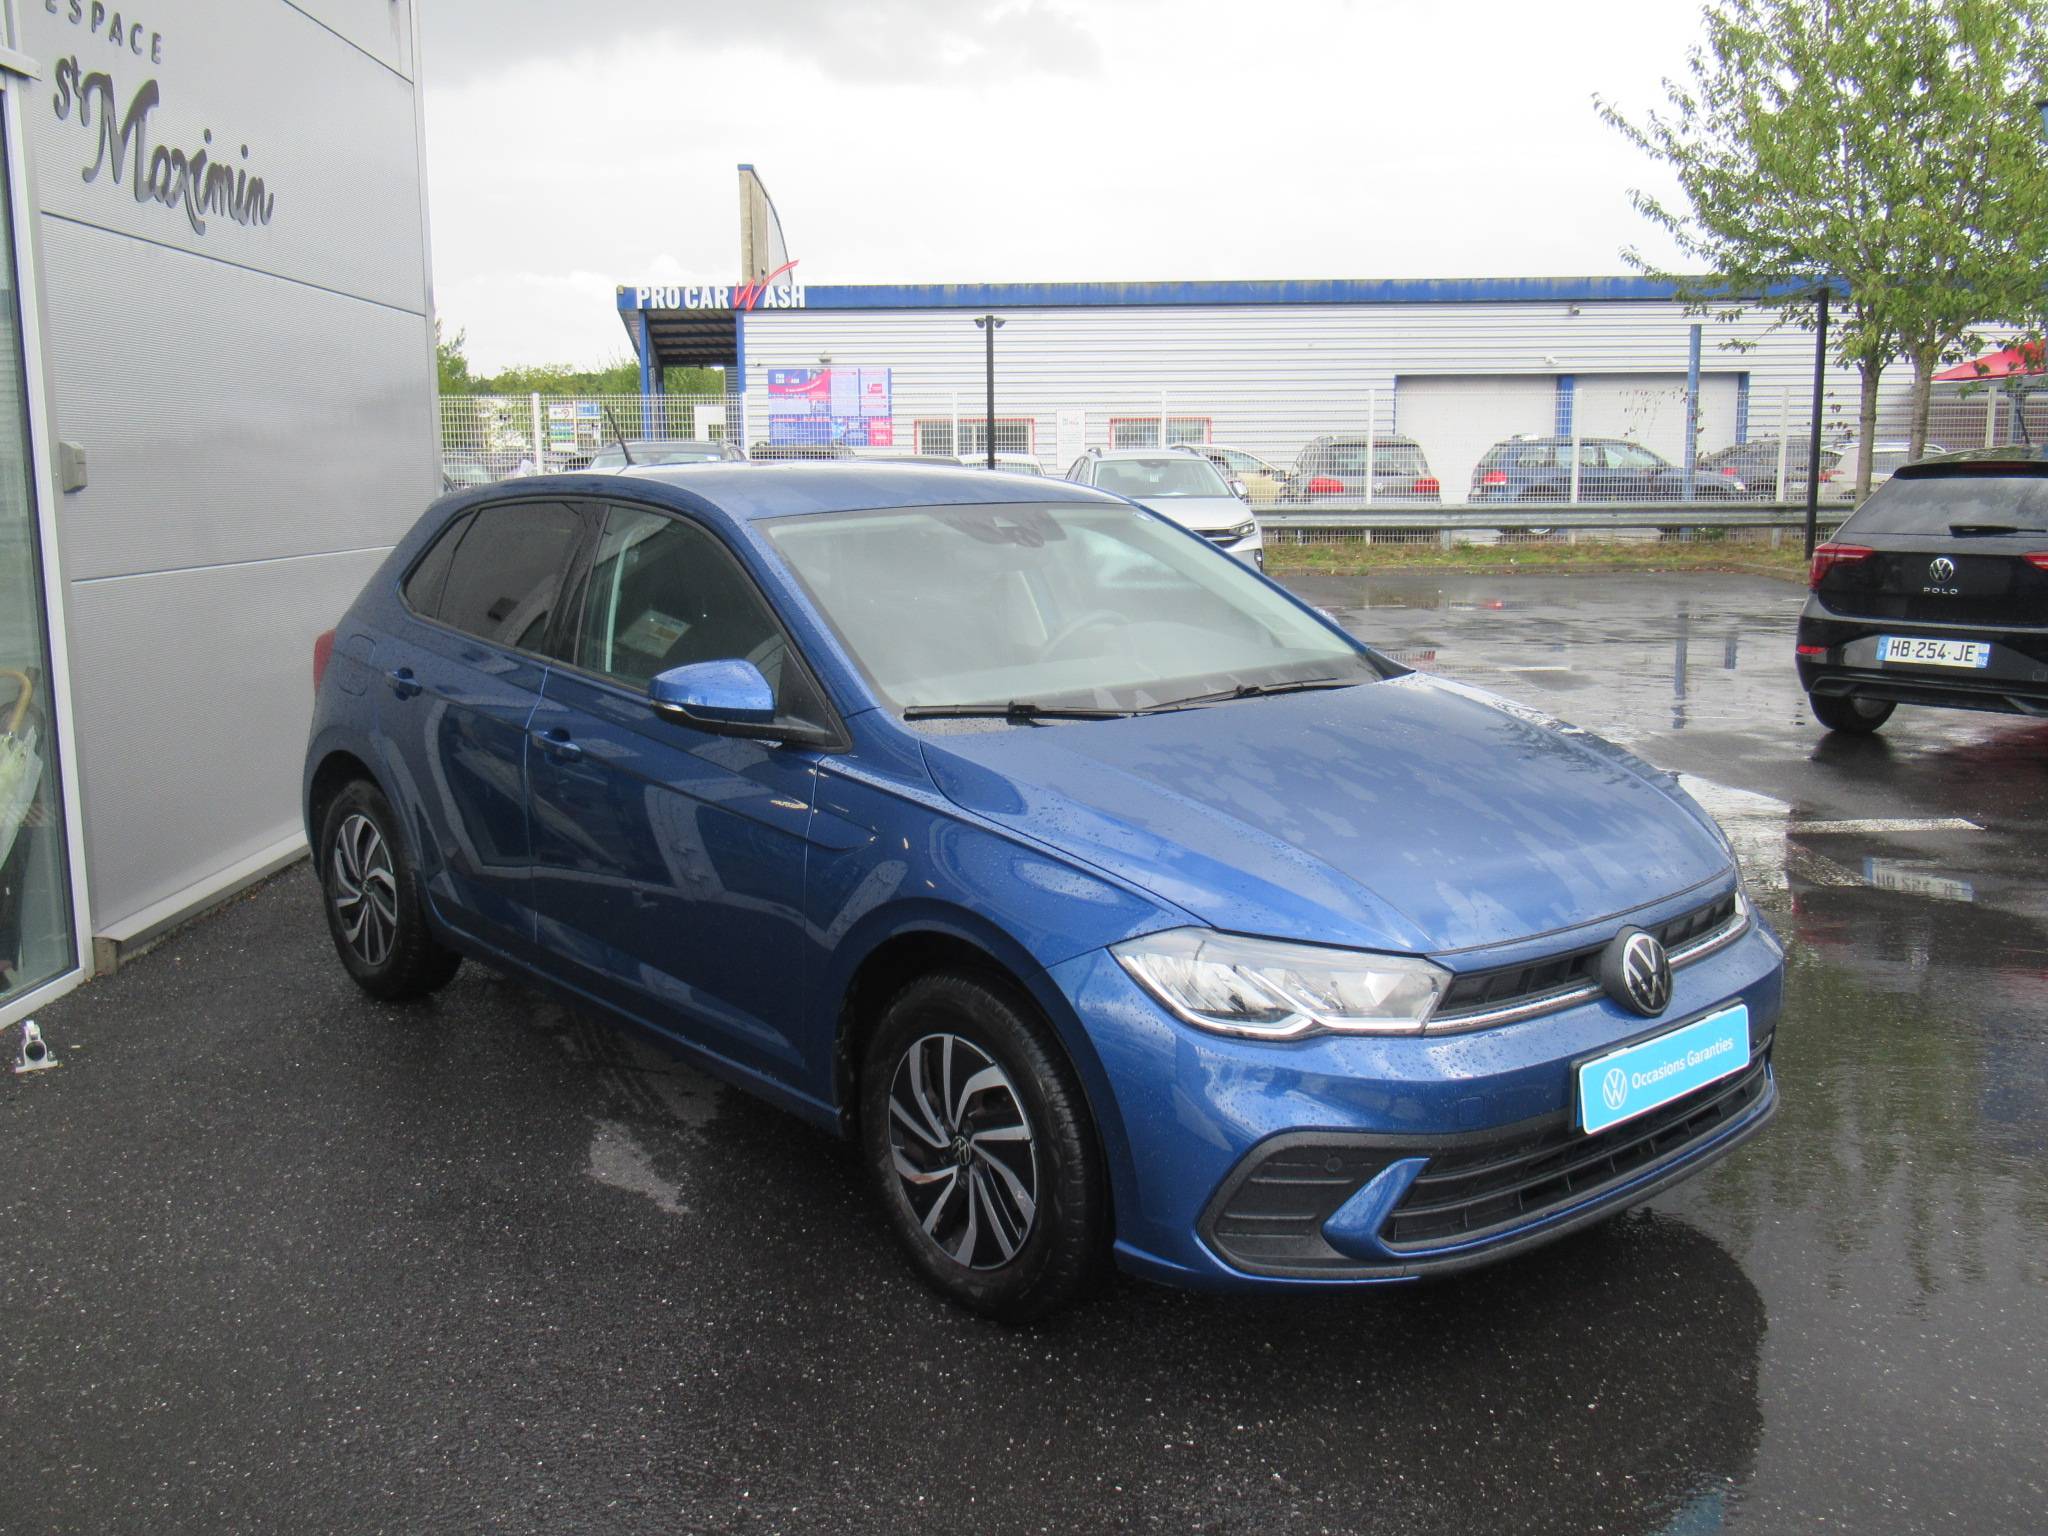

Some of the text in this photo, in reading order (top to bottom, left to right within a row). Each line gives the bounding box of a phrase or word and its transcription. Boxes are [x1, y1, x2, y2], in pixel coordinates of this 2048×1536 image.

[80, 73, 275, 236] Maximin
[636, 260, 806, 311] PRO CAR WASH
[1923, 587, 1959, 595] POLO
[1631, 1036, 1733, 1089] Occasions Garanties
